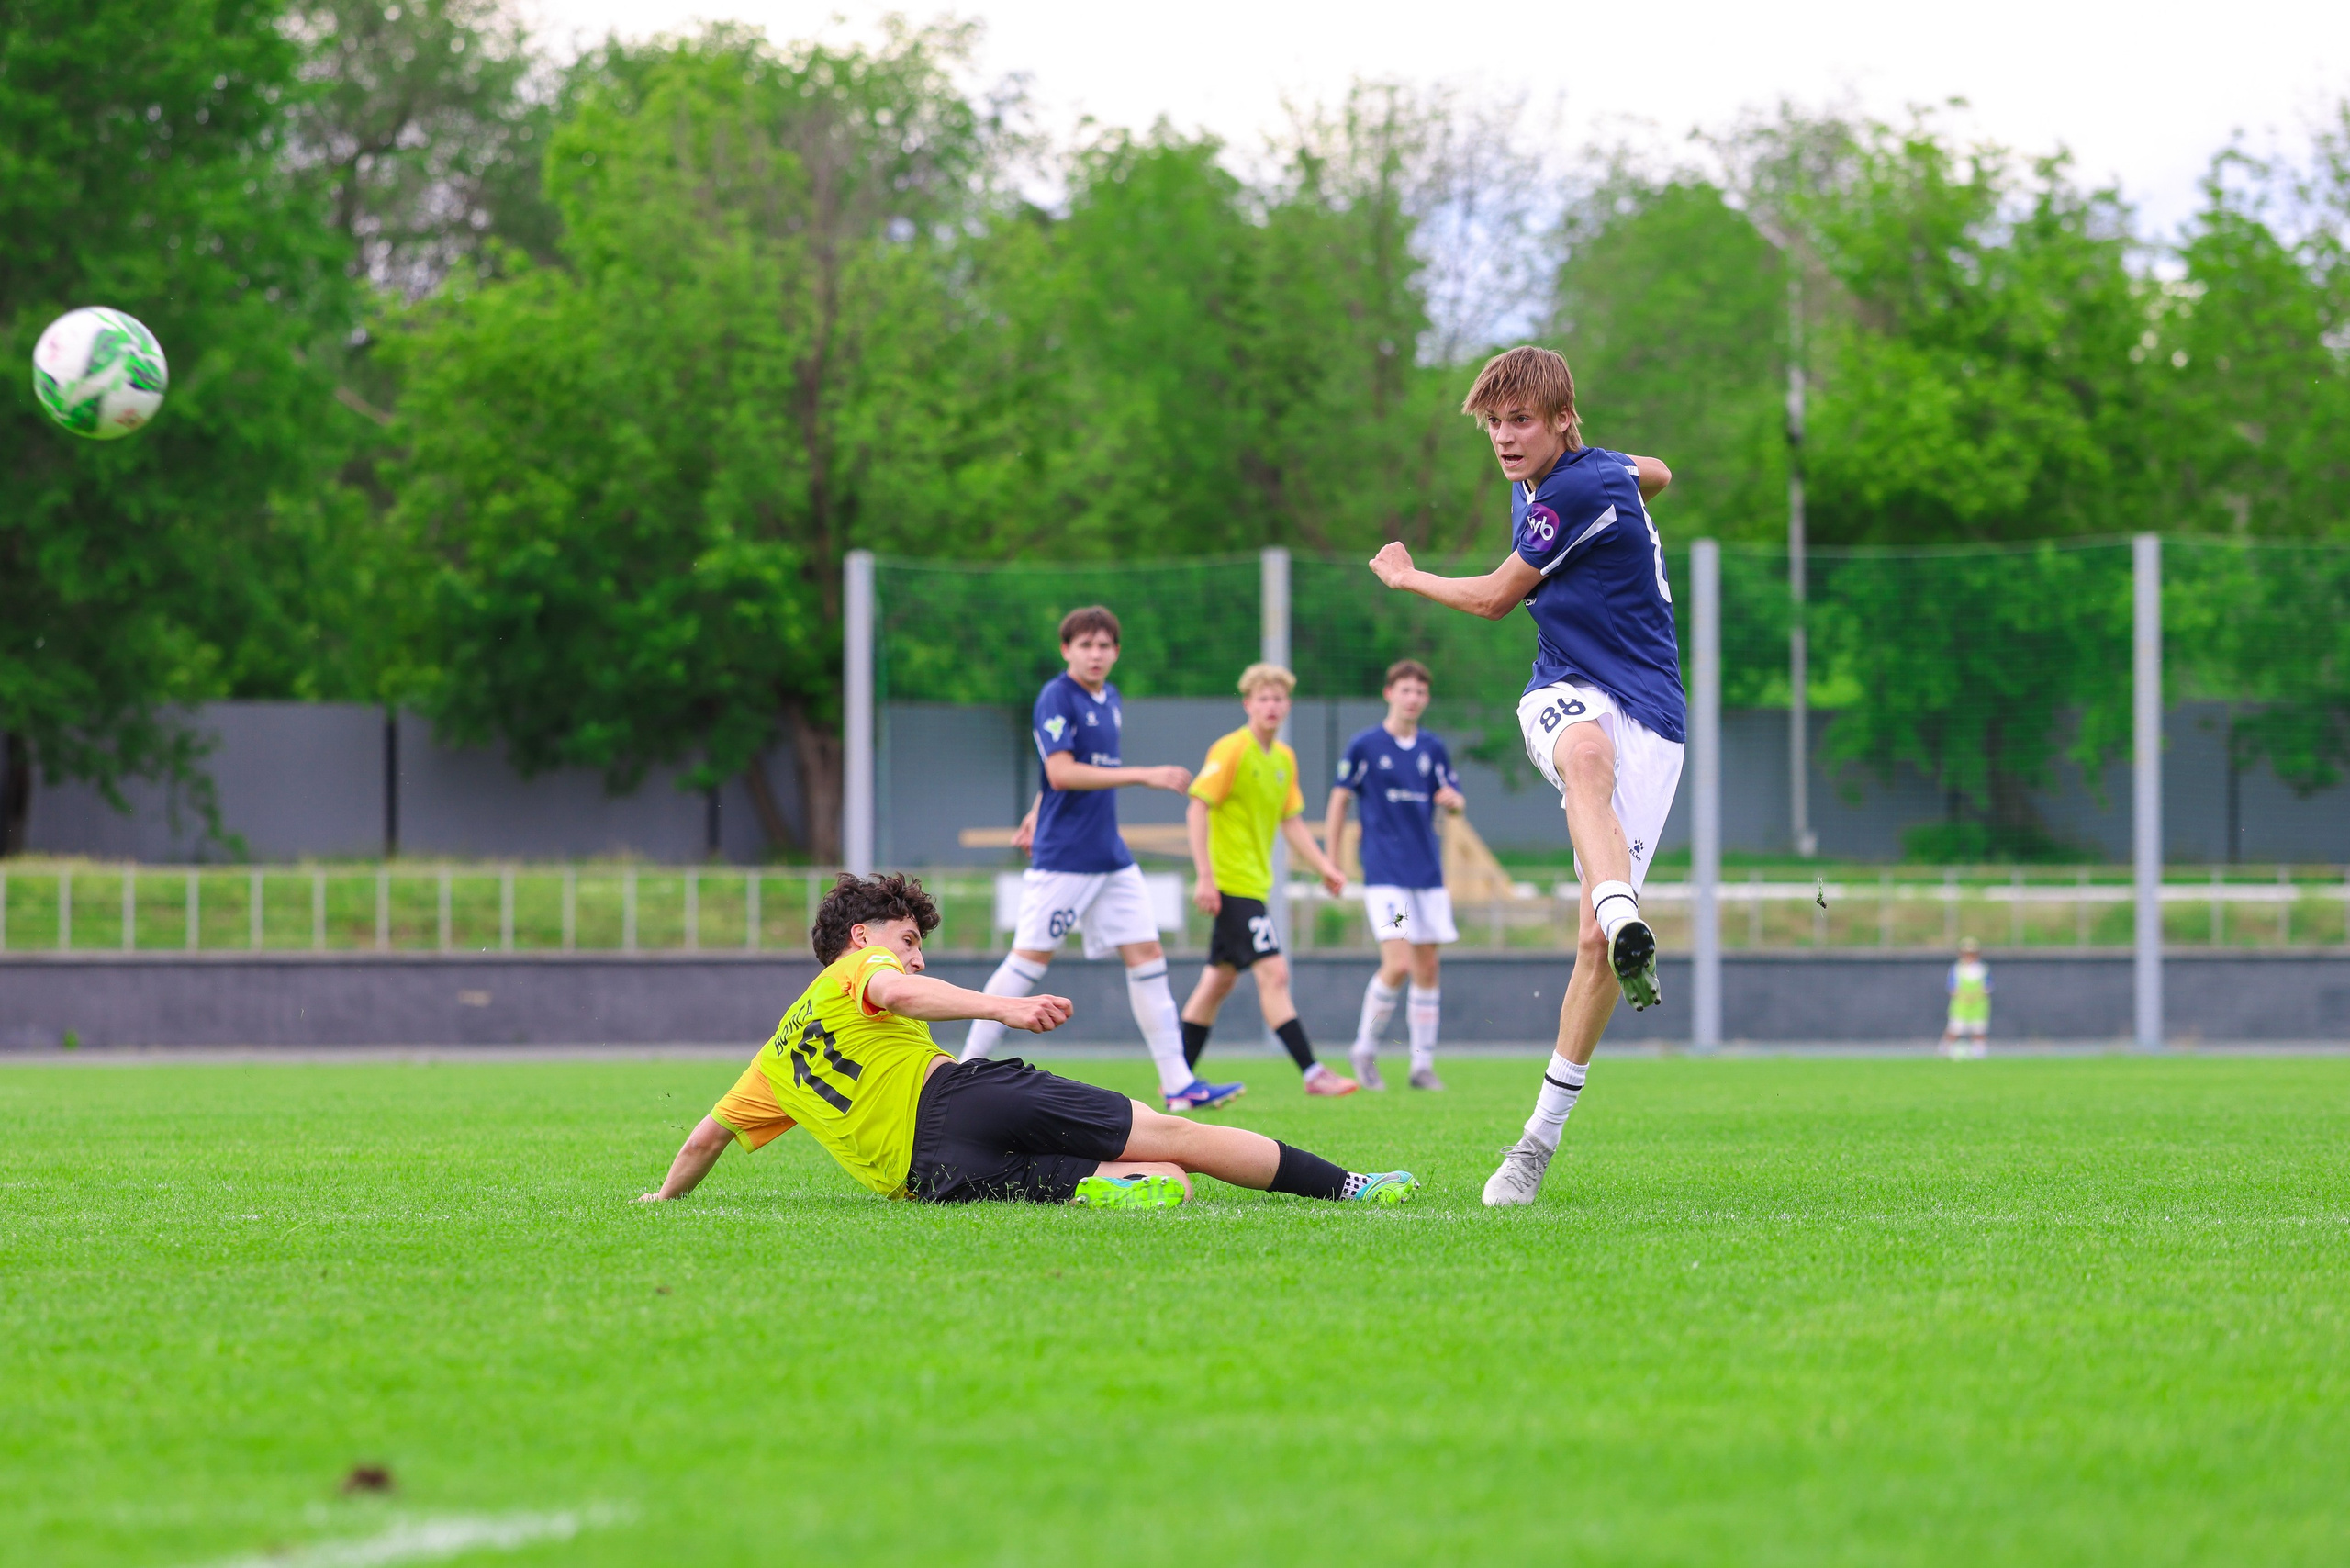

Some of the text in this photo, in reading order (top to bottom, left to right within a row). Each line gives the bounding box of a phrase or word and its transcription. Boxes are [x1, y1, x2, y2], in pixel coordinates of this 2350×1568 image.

[1539, 698, 1586, 734] 88
[1628, 846, 1642, 864] ELME
[1049, 908, 1078, 938] 69
[774, 999, 813, 1058] ВОЛГА
